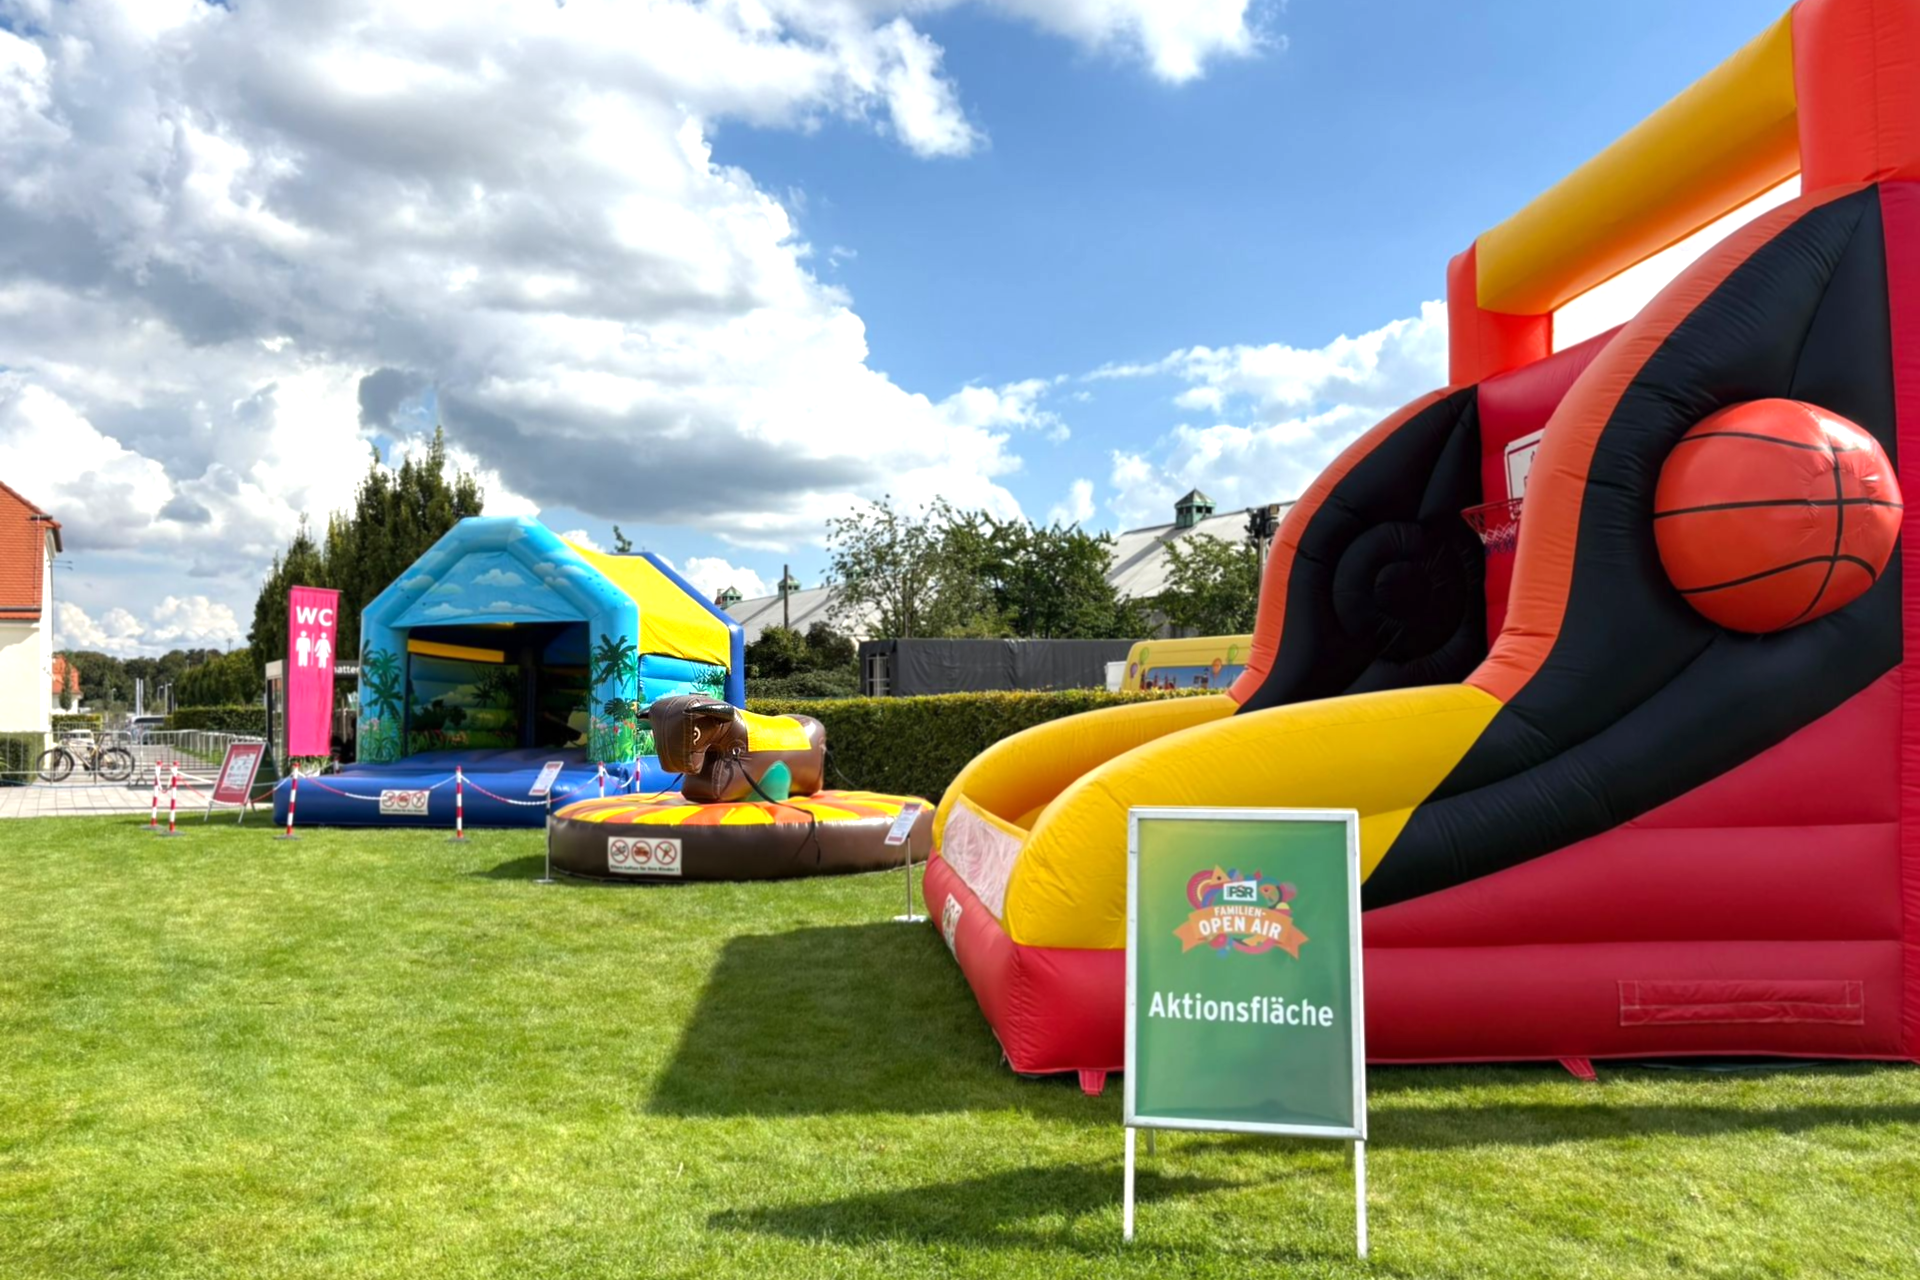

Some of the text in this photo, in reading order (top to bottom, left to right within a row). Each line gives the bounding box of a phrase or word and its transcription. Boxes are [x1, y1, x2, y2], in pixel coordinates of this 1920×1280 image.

[296, 605, 333, 627] WC
[1229, 884, 1254, 899] PSR
[1214, 905, 1266, 917] FAMILIEN-
[1199, 916, 1282, 940] OPEN AIR
[1148, 991, 1334, 1027] Aktionsfläche
